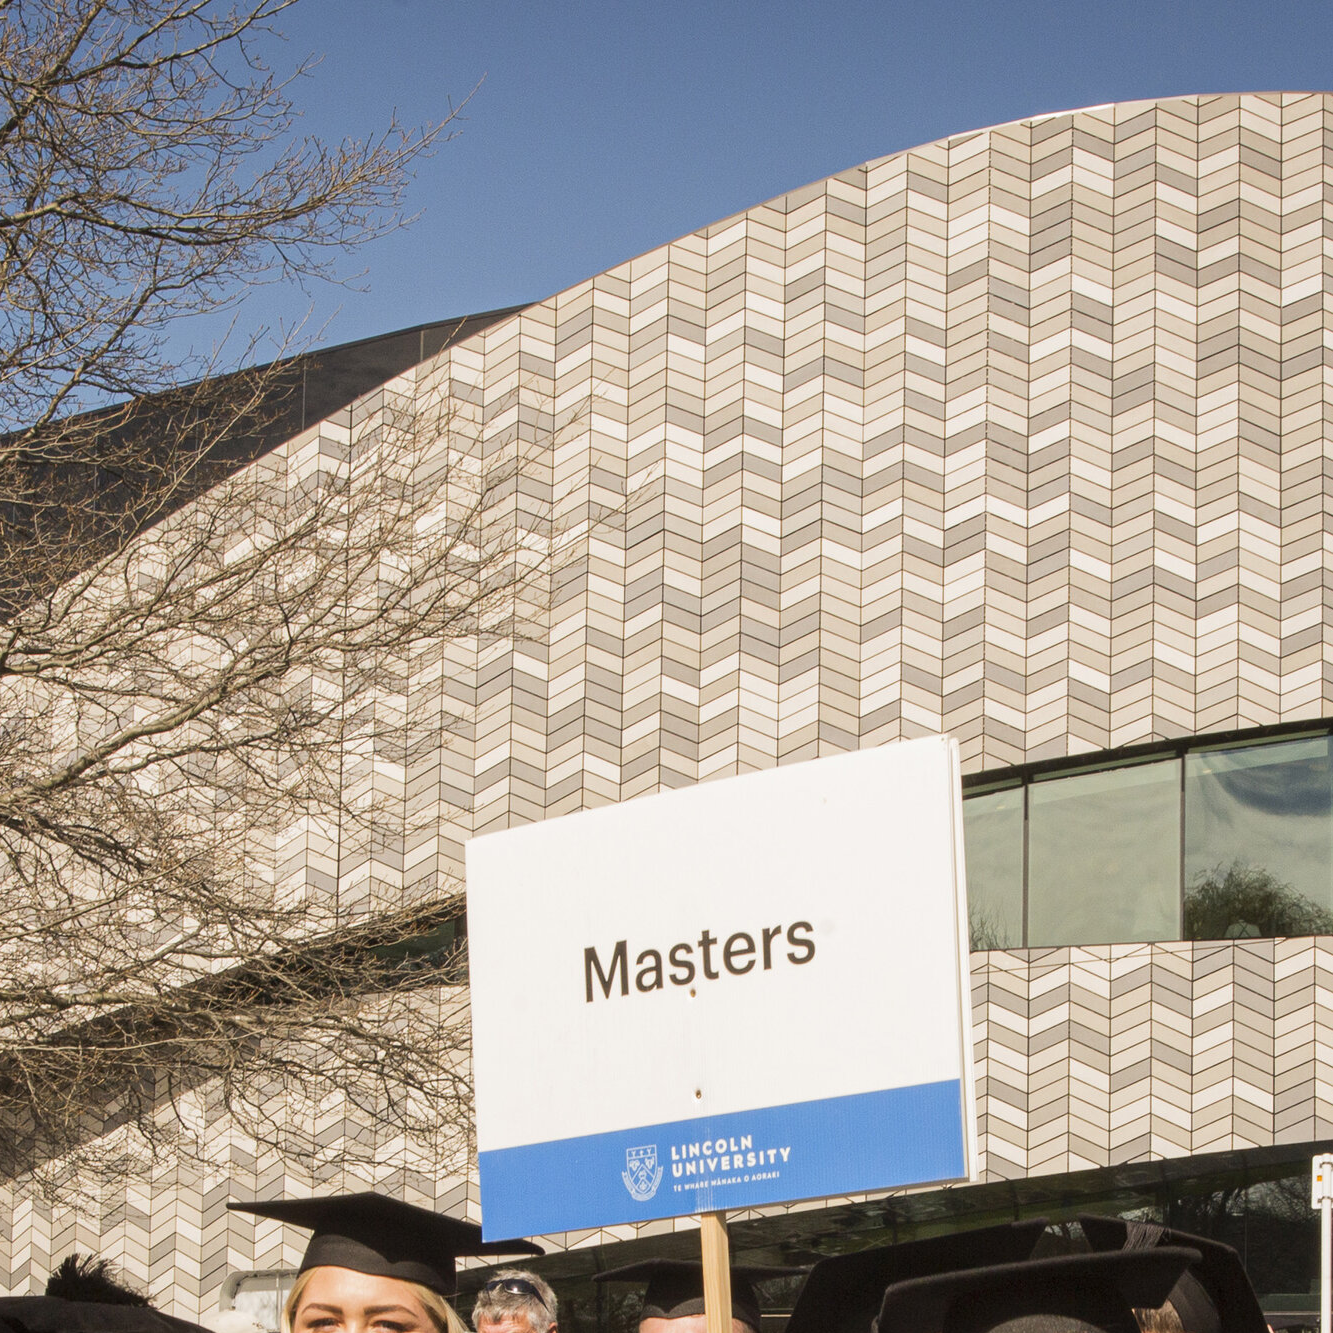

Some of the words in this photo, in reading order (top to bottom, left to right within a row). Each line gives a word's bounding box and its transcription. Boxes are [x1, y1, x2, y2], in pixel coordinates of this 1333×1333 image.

[584, 919, 817, 1003] Masters
[671, 1134, 753, 1161] LINCOLN
[671, 1146, 791, 1178] UNIVERSITY
[673, 1184, 682, 1193] TE
